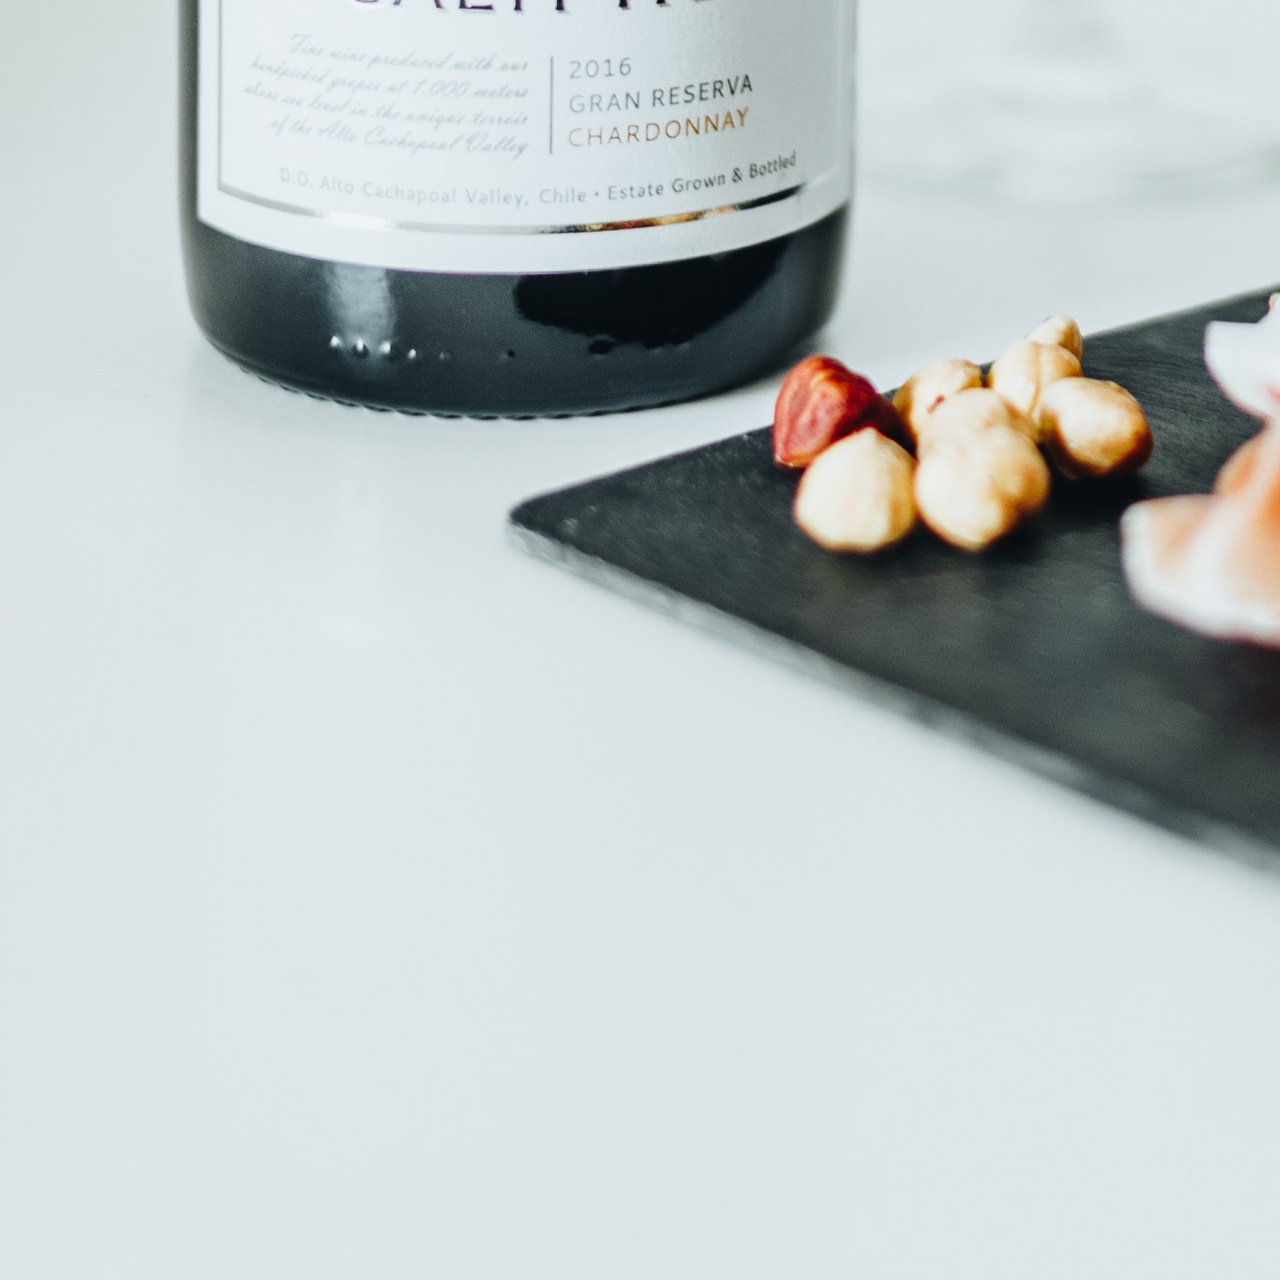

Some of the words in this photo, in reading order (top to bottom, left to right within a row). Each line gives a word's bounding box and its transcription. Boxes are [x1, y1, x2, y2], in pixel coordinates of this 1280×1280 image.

[290, 32, 325, 56] Fine
[327, 46, 366, 62] wine
[366, 50, 454, 70] produced
[451, 52, 497, 71] with
[497, 60, 529, 71] our
[569, 57, 632, 79] 2016
[248, 53, 332, 83] handpicked
[326, 77, 382, 94] grapes
[384, 79, 409, 93] at
[413, 78, 471, 97] 1.000
[471, 83, 529, 98] meters
[569, 91, 640, 114] GRAN
[652, 74, 753, 107] RESERVA
[243, 80, 279, 101] above
[282, 95, 304, 106] sea
[307, 93, 352, 113] level
[347, 102, 369, 116] in
[372, 102, 401, 119] the
[404, 109, 466, 130] unique
[469, 110, 529, 125] terroir
[568, 106, 750, 147] CHARDONNAY
[269, 114, 292, 136] of
[288, 118, 313, 135] the
[317, 120, 358, 142] Alto
[364, 125, 464, 154] Cachapoal
[465, 131, 530, 160] Valley
[280, 166, 315, 188] D.O.
[320, 175, 354, 195] Alto
[362, 181, 457, 205] Cachapoal
[465, 187, 529, 209] Valley,
[539, 187, 587, 203] Chile
[608, 181, 664, 201] Estate
[672, 172, 726, 194] Grown
[732, 167, 743, 183] &
[749, 149, 797, 178] Bottled
